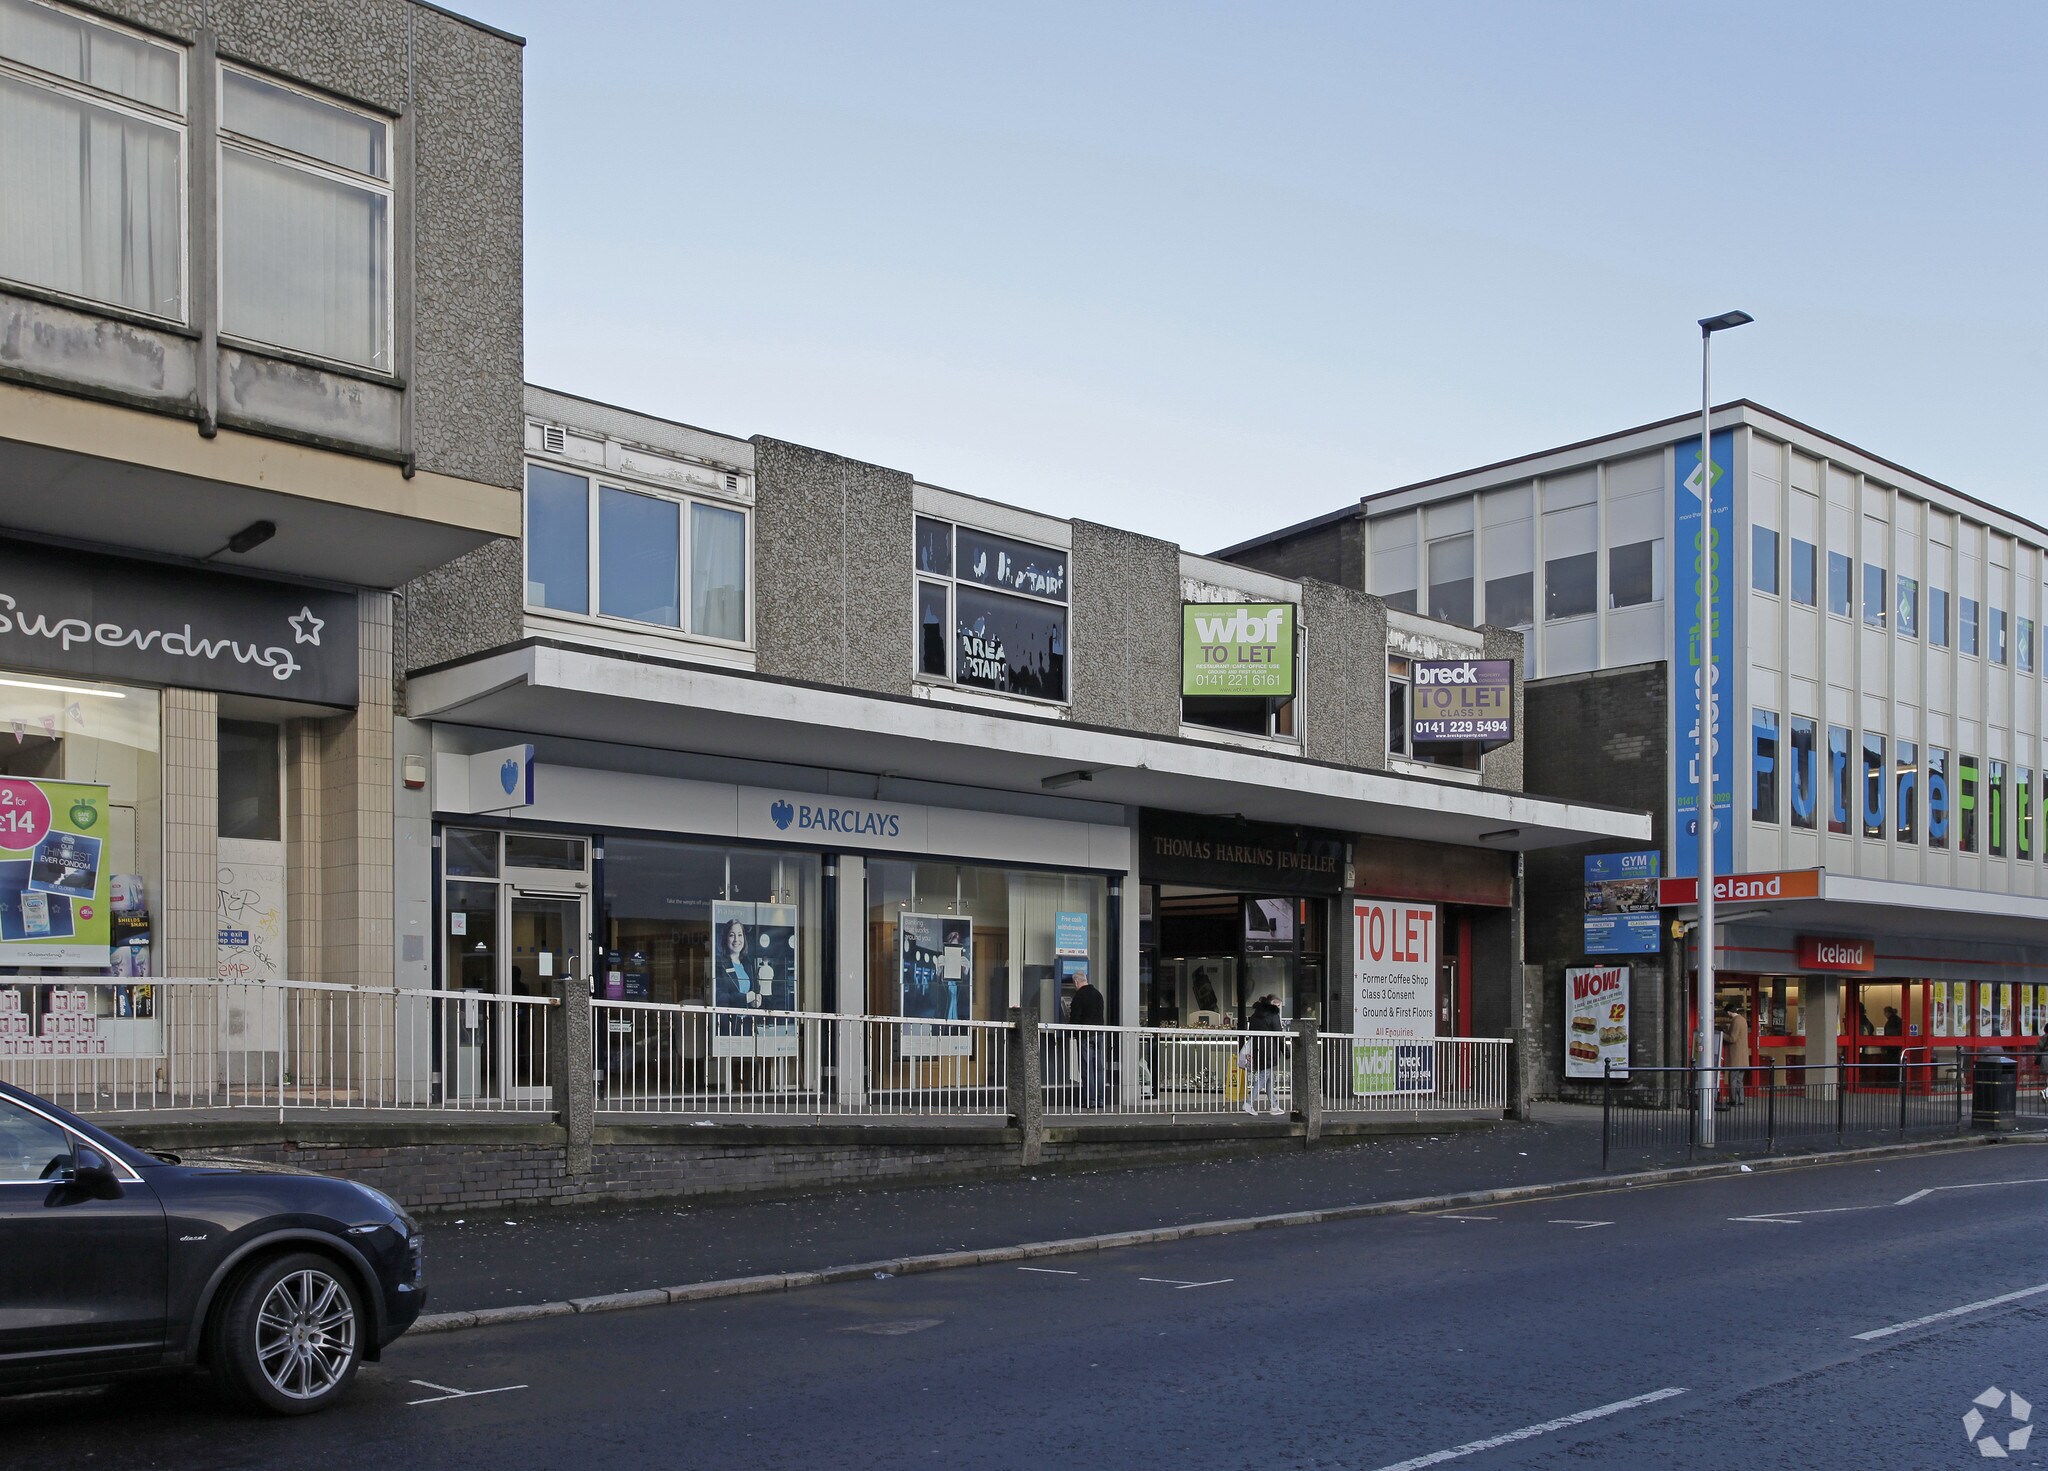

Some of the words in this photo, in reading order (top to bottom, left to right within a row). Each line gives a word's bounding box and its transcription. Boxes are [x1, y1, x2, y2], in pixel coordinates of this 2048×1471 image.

[1194, 609, 1283, 643] wbf
[0, 592, 301, 681] Superdrug
[1200, 645, 1228, 663] TO
[1238, 645, 1276, 663] LET
[1196, 674, 1224, 686] 0141
[1228, 674, 1248, 686] 221
[1252, 674, 1280, 686] 6161
[1415, 662, 1478, 685] breck
[1418, 687, 1452, 708] TO
[1461, 687, 1505, 708] LET
[1440, 708, 1474, 717] CLASS
[1478, 709, 1483, 717] 3
[1415, 721, 1445, 733] 0141
[1450, 721, 1473, 733] 229
[1477, 720, 1507, 732] 5494
[0, 789, 14, 806] 2
[16, 796, 27, 806] for
[799, 805, 899, 837] BARCLAYS
[40, 856, 58, 866] EVER
[59, 858, 91, 870] CONDOM
[1154, 836, 1211, 860] THOMAS
[1216, 843, 1273, 866] HARKINS
[1277, 851, 1336, 873] JEWELLER
[1621, 854, 1647, 867] GYM
[1355, 906, 1385, 962] TO
[1392, 909, 1433, 963] LET
[1817, 943, 1863, 965] Iceland
[1362, 973, 1387, 984] Former
[1388, 973, 1411, 985] Coffee
[1411, 974, 1429, 987] Shop
[1573, 967, 1621, 1001] WOW!
[1362, 988, 1381, 999] Class
[1382, 989, 1386, 999] 3
[1387, 989, 1415, 1000] Consent
[1362, 1007, 1388, 1018] Ground
[1389, 1007, 1394, 1017] &
[1395, 1007, 1411, 1018] First
[1412, 1007, 1433, 1018] Floors
[1609, 1003, 1626, 1019] £2
[1376, 1027, 1384, 1036] All
[1385, 1028, 1414, 1037] Enquiries
